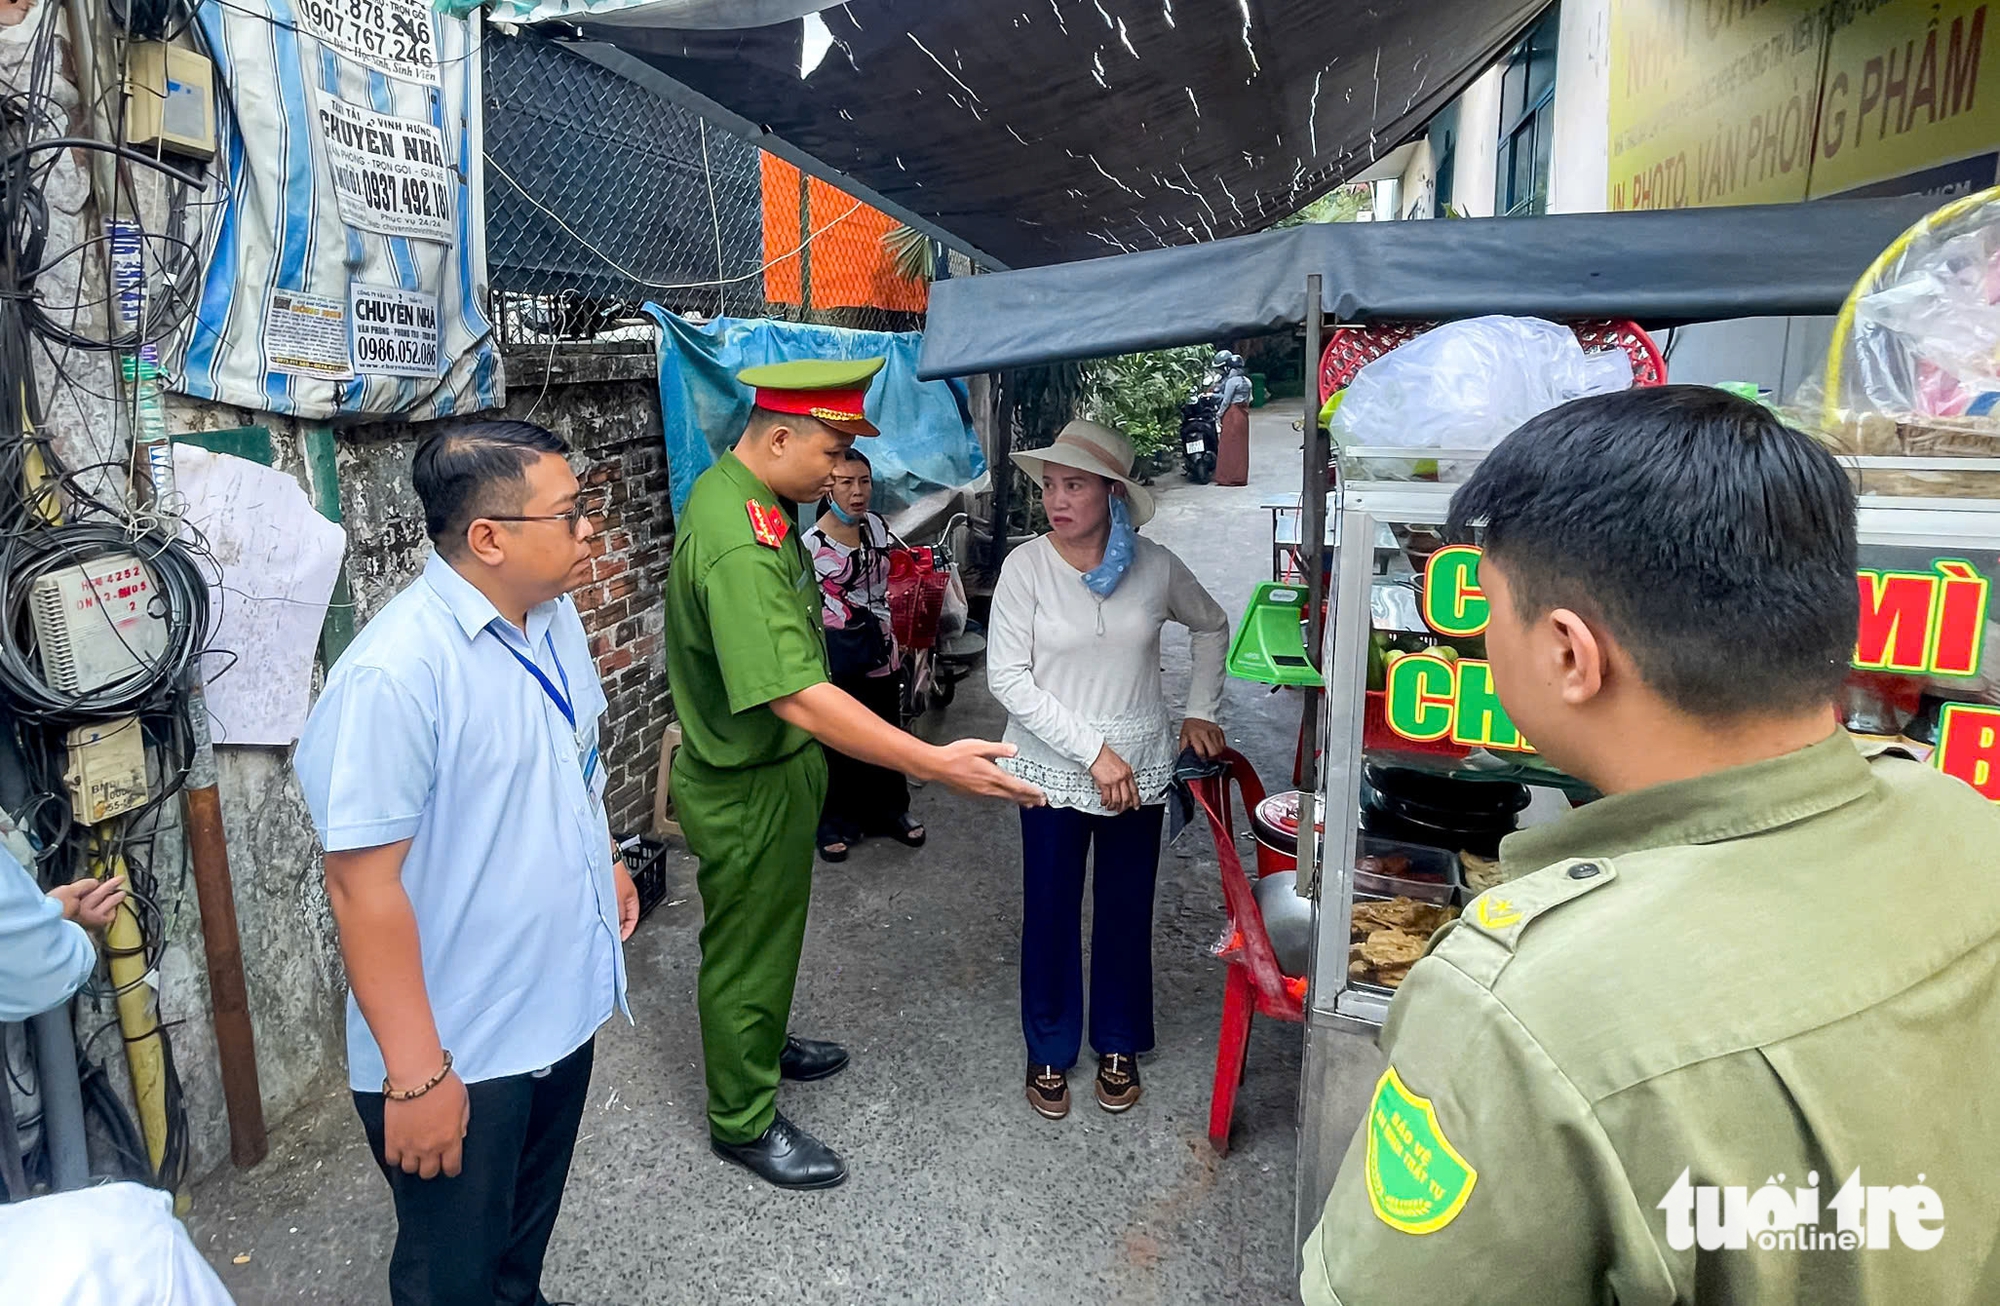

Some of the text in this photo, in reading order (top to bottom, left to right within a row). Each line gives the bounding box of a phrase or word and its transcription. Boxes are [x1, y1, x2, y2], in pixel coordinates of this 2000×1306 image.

[392, 63, 412, 77] Sinh
[415, 67, 436, 81] Viên
[1699, 118, 1740, 203] VĂN
[1744, 71, 1848, 188] PHÒNG
[1856, 3, 1988, 148] PHẨM
[319, 109, 444, 168] CHUYỂN NHÀ
[346, 105, 361, 120] TẢI
[377, 118, 402, 131] VINH
[406, 122, 431, 137] HƯNG
[372, 160, 393, 173] TRỌN
[395, 163, 412, 175] GÓI
[362, 169, 450, 221] 0937.492.181
[419, 217, 441, 228] 24/24
[355, 294, 413, 326] CHUYỂN
[417, 306, 436, 329] NHÀ
[107, 566, 140, 583] 4252
[1851, 557, 1993, 679] MÌ
[1385, 653, 1538, 755] CH
